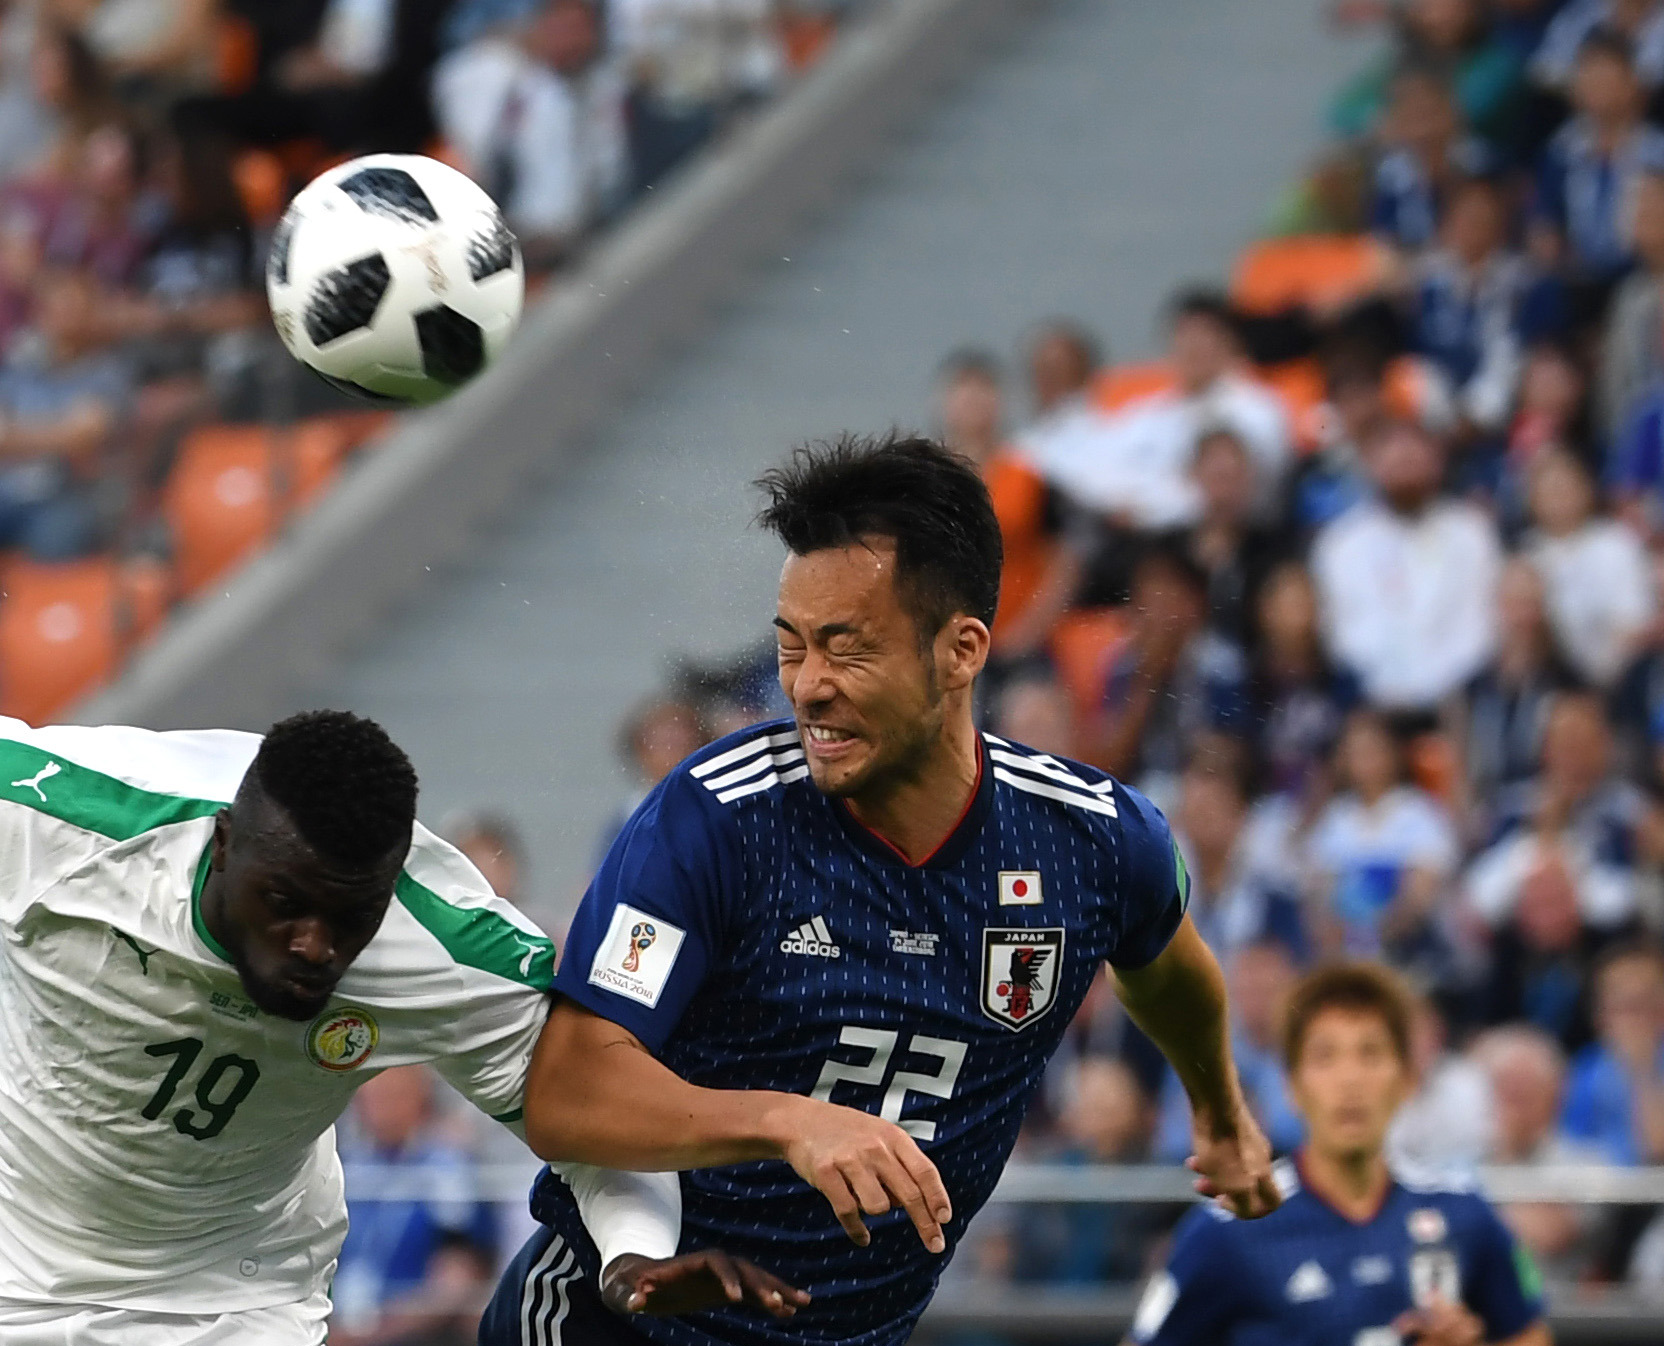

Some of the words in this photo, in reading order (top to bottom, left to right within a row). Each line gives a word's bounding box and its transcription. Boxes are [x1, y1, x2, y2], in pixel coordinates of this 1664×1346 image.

[780, 938, 841, 958] adidas
[1004, 933, 1045, 942] JAPAN
[141, 1037, 261, 1141] 19
[809, 1025, 969, 1142] 22
